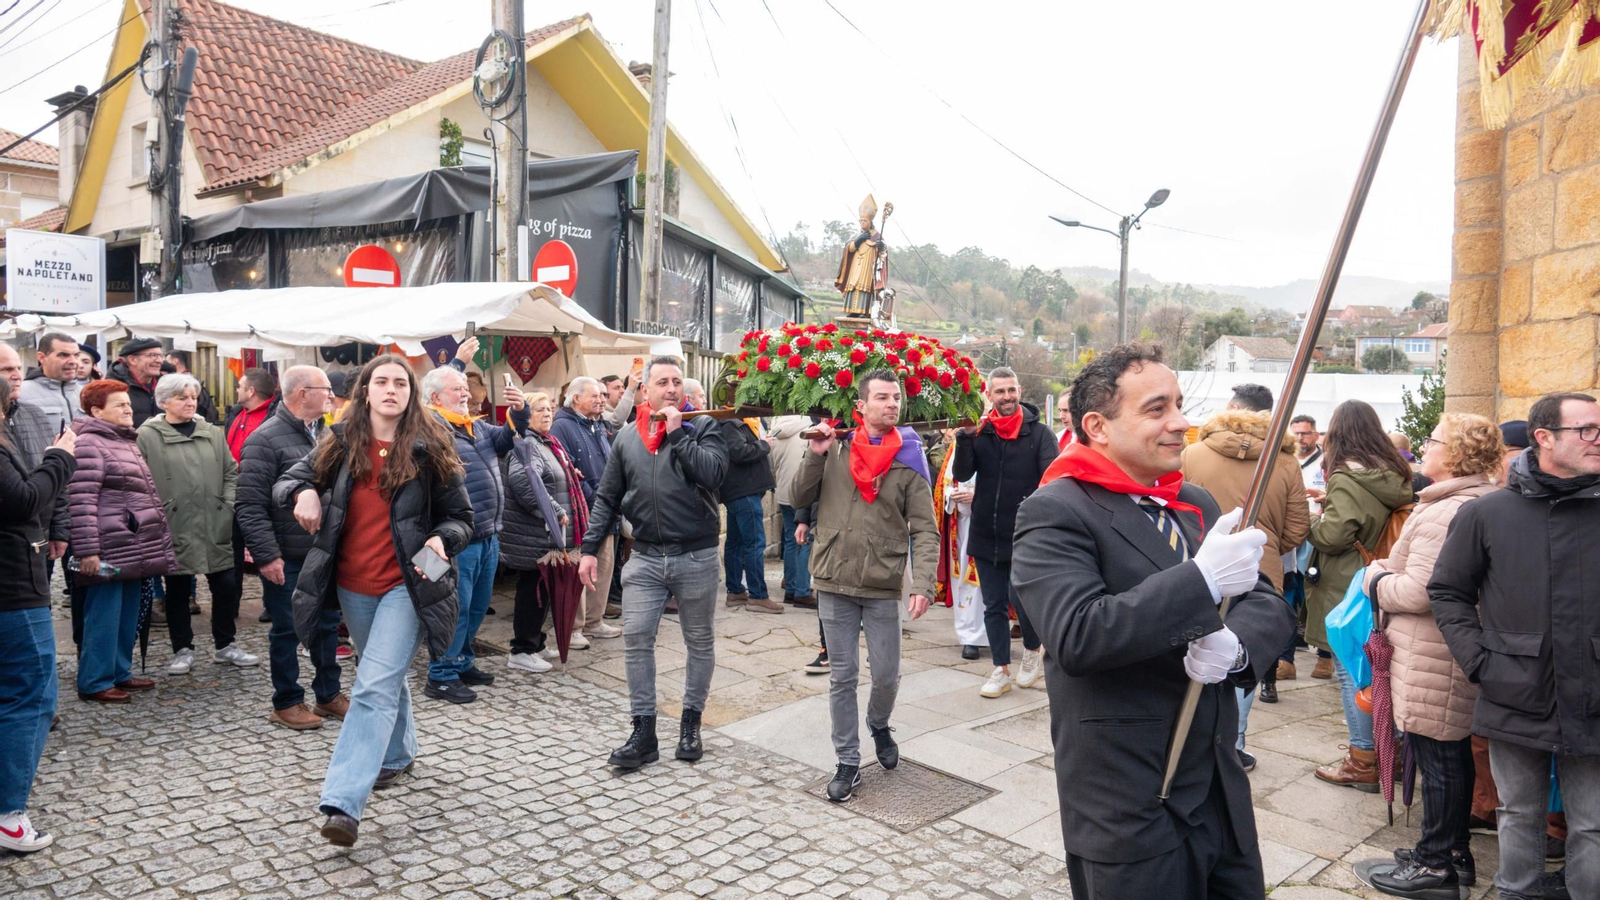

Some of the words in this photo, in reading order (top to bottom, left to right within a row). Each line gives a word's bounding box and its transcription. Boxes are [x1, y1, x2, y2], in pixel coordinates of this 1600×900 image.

[543, 218, 558, 238] of
[559, 221, 593, 240] pizza
[34, 259, 72, 271] MEZZO
[17, 267, 93, 282] NAPOLETANO
